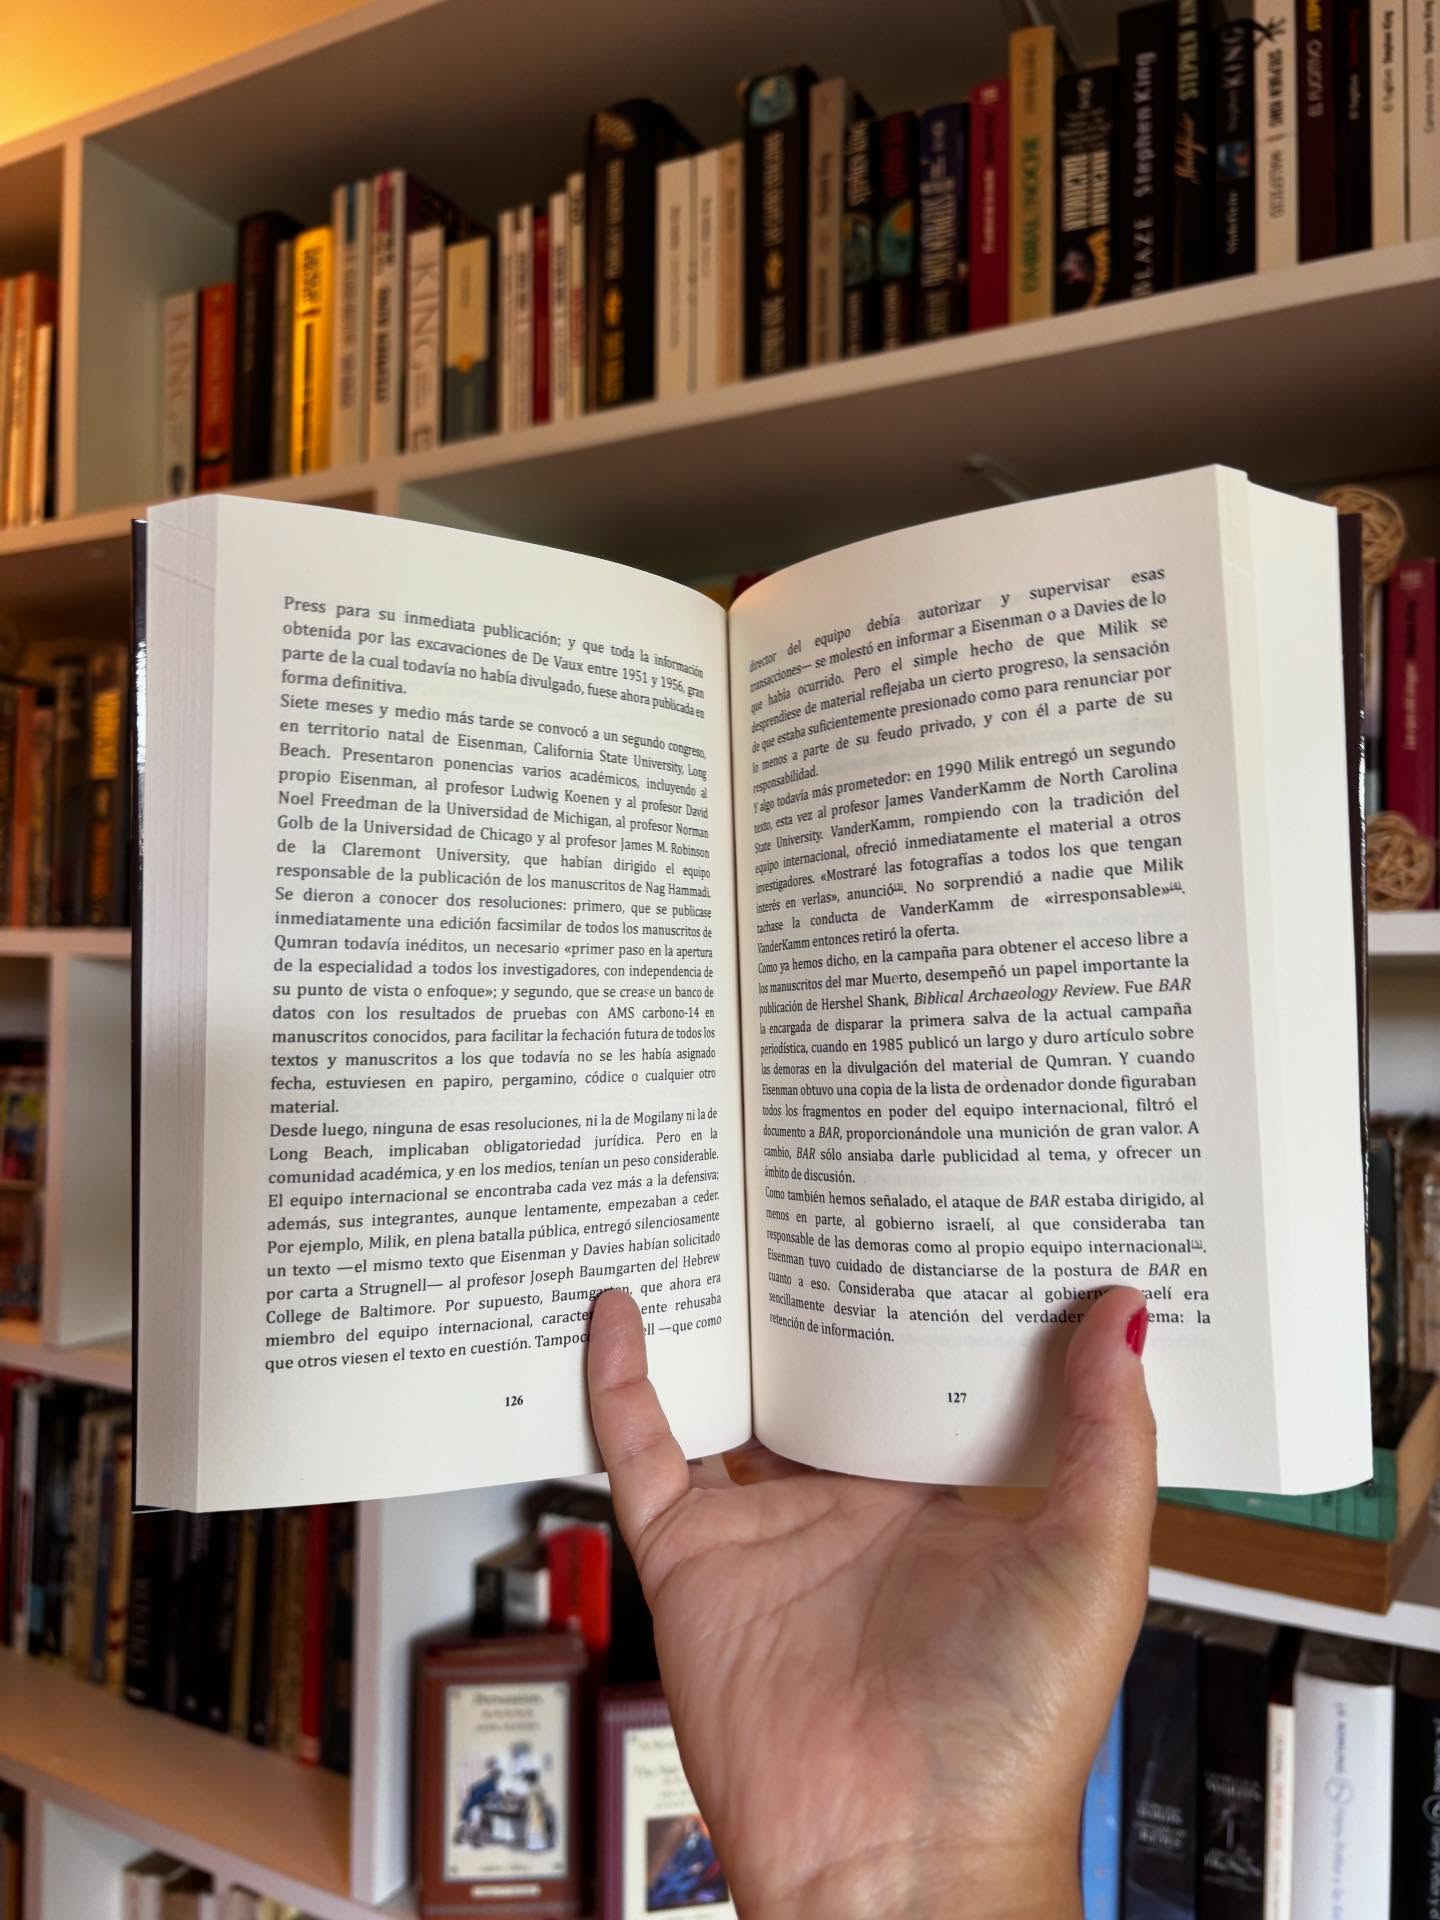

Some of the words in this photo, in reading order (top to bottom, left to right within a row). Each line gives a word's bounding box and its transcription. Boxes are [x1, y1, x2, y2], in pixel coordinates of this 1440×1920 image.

[1177, 0, 1200, 26] KIN
[1132, 51, 1158, 102] King
[1220, 26, 1247, 88] KING
[1133, 107, 1157, 198] Stephen
[1132, 216, 1154, 297] BLAZE
[284, 596, 326, 614] Press
[336, 605, 370, 619] para
[378, 610, 396, 622] su
[404, 610, 476, 632] inmediata
[482, 623, 561, 648] publicación;
[567, 638, 576, 651] y
[582, 641, 605, 655] que
[610, 645, 635, 660] toda
[639, 648, 650, 663] la
[654, 653, 704, 679] información
[749, 652, 777, 673] director
[787, 640, 802, 656] del
[814, 628, 852, 648] equipo
[866, 613, 901, 632] debía
[918, 598, 982, 620] autorizar
[1000, 594, 1010, 608] y
[1029, 577, 1111, 600] supervisar
[1130, 568, 1166, 584] esas
[279, 721, 299, 733] en
[307, 722, 380, 739] territorio
[387, 729, 424, 743] natal
[432, 730, 450, 746] de
[457, 733, 527, 755] Eisenman,
[533, 741, 594, 761] California
[599, 749, 628, 765] State
[633, 754, 684, 776] University,
[688, 764, 708, 782] Long
[279, 742, 331, 759] Beach.
[342, 746, 434, 767] Presentaron
[443, 759, 514, 775] ponencias
[522, 765, 562, 779] varios
[569, 770, 640, 789] académicos,
[646, 777, 696, 796] incluyendo
[700, 787, 708, 799] al
[754, 821, 773, 834] texto,
[775, 816, 794, 828] esta
[796, 811, 813, 823] vez
[817, 805, 827, 819] al
[831, 799, 880, 820] profesor
[885, 793, 924, 810] James
[929, 780, 1026, 801] VanderKamm
[1033, 774, 1052, 789] de
[1059, 768, 1104, 786] North
[1112, 762, 1178, 780] Carolina
[276, 838, 296, 853] de
[312, 840, 326, 855] la
[342, 842, 422, 860] Claremont
[436, 847, 510, 867] University,
[523, 855, 548, 869] que
[560, 854, 602, 870] habían
[613, 857, 657, 875] dirigido
[665, 862, 675, 875] el
[682, 866, 711, 881] equipo
[272, 1005, 316, 1020] datos
[326, 1009, 355, 1020] con
[366, 1006, 388, 1020] los
[399, 1006, 476, 1020] resultados
[486, 1006, 503, 1020] de
[512, 1006, 567, 1023] pruebas
[576, 1010, 599, 1020] con
[607, 1006, 635, 1019] AMS
[642, 1006, 700, 1019] carbono-14
[704, 1009, 715, 1018] en
[759, 1000, 803, 1016] publicación
[806, 998, 818, 1011] de
[821, 995, 864, 1010] Hershel
[867, 992, 909, 1008] Shank,
[913, 989, 964, 1006] Biblical
[967, 985, 1058, 1003] Archaeology
[1062, 982, 1120, 998] Review.
[1124, 980, 1153, 994] Fue
[1158, 977, 1192, 992] BAR
[270, 1076, 316, 1092] fecha,
[325, 1076, 406, 1090] estuviesen
[415, 1078, 434, 1088] en
[443, 1074, 493, 1091] papiro,
[501, 1072, 577, 1090] pergamino,
[584, 1070, 625, 1084] códice
[631, 1073, 639, 1082] o
[645, 1068, 694, 1084] cualquier
[698, 1068, 716, 1079] otro
[764, 1144, 792, 1160] cambio,
[796, 1146, 816, 1160] BAR
[820, 1147, 842, 1161] sólo
[847, 1148, 894, 1162] ansiaba
[900, 1148, 936, 1163] darle
[942, 1148, 1020, 1166] publicidad
[1027, 1147, 1041, 1162] al
[1048, 1149, 1091, 1162] tema,
[1098, 1149, 1108, 1164] y
[1116, 1145, 1173, 1160] ofrecer
[1180, 1148, 1202, 1158] un
[267, 1215, 330, 1231] además,
[338, 1217, 364, 1229] sus
[372, 1212, 458, 1229] integrantes,
[465, 1208, 518, 1223] aunque
[524, 1202, 602, 1218] lentamente,
[608, 1194, 677, 1213] empezaban
[682, 1195, 688, 1205] a
[693, 1189, 720, 1204] ceder.
[766, 1209, 790, 1222] menos
[796, 1213, 808, 1224] en
[814, 1215, 846, 1228] parte,
[854, 1214, 865, 1228] al
[875, 1216, 934, 1232] gobierno
[946, 1217, 994, 1233] israelí,
[1006, 1216, 1020, 1231] al
[1032, 1220, 1061, 1234] que
[1072, 1215, 1167, 1231] consideraba
[1179, 1217, 1205, 1230] tan
[505, 1394, 524, 1407] 126
[947, 1392, 967, 1404] 127
